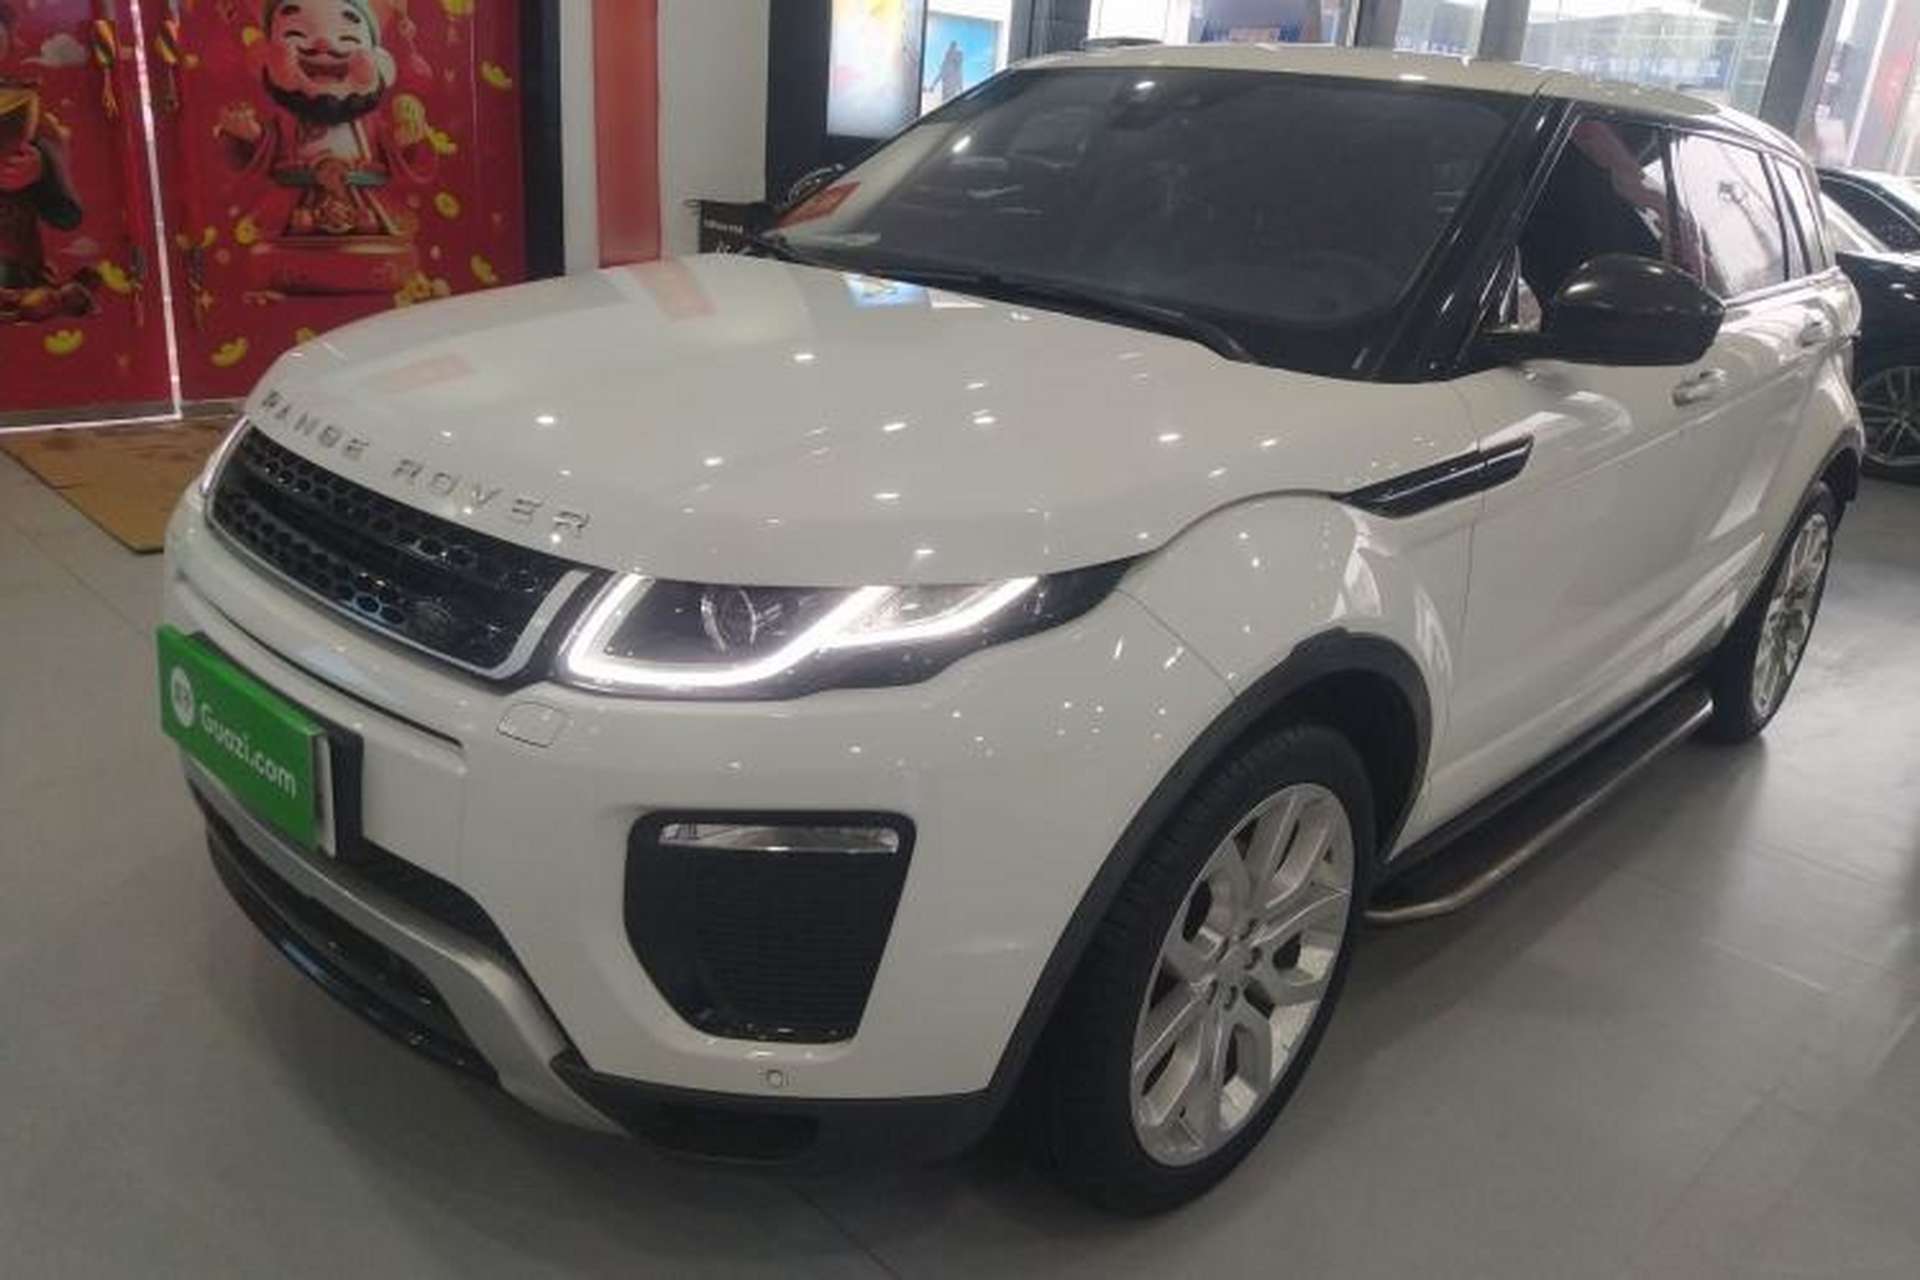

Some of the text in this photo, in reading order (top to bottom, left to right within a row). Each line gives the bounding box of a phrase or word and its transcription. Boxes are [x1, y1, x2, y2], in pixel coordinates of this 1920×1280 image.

[261, 389, 591, 540] RANGE ROVER
[201, 702, 297, 800] Guazi.com
